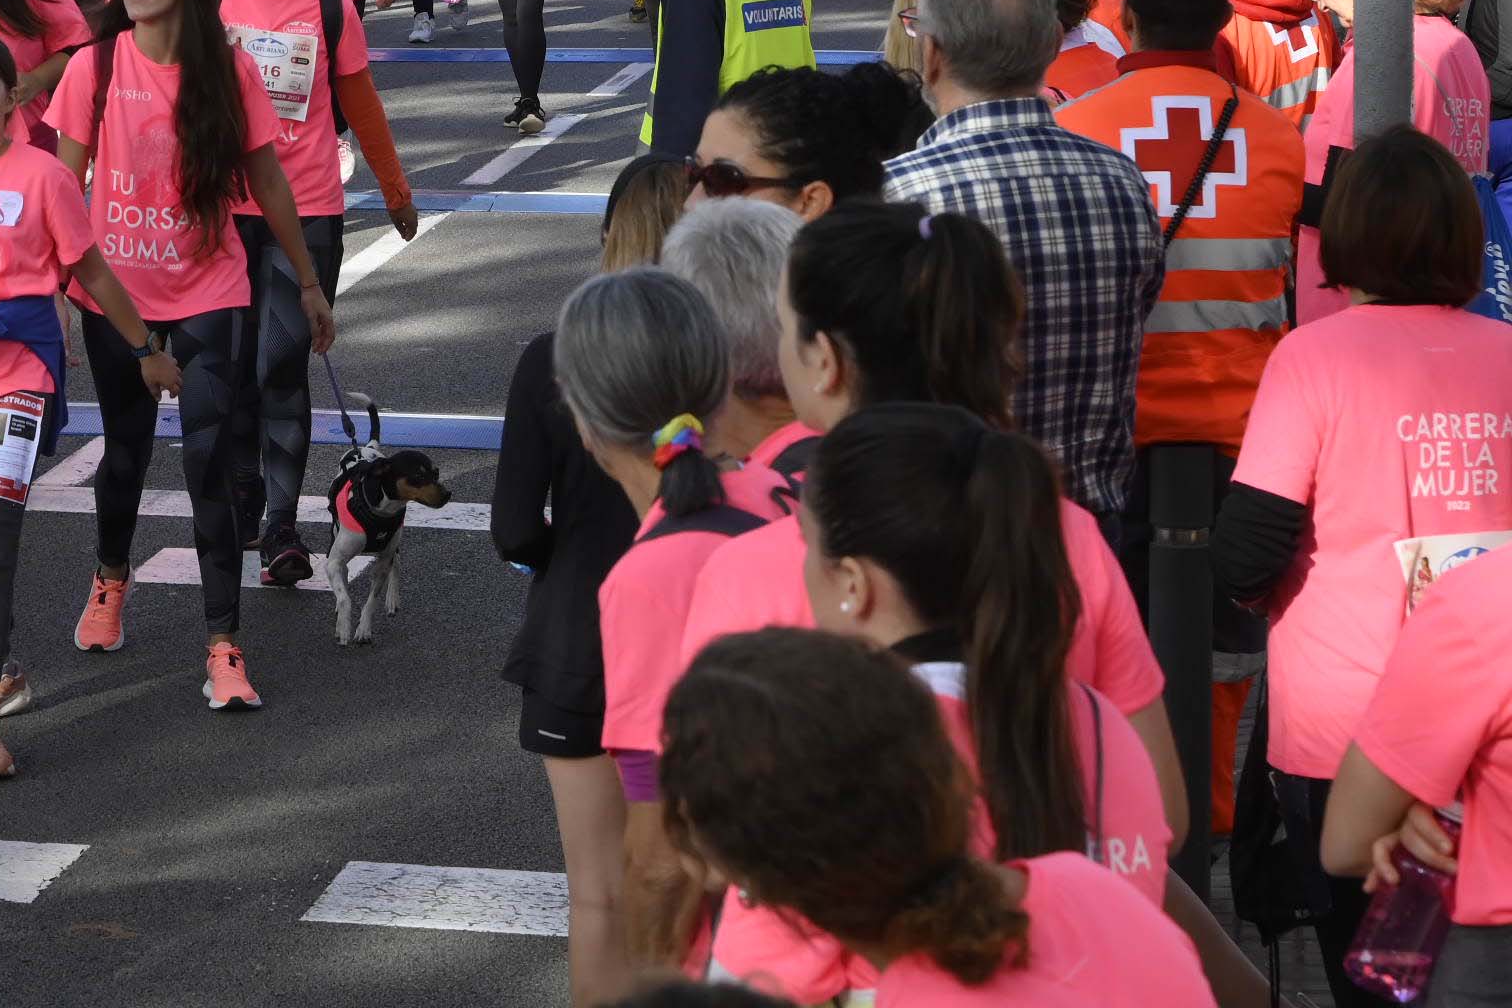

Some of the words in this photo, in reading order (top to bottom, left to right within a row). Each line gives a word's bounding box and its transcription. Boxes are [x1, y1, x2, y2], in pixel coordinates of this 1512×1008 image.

[744, 5, 804, 25] VOLUNTARIS
[260, 64, 281, 78] 16
[110, 169, 135, 196] TU
[107, 201, 201, 231] DORSA
[104, 234, 180, 262] SUMA
[1419, 442, 1451, 469] DE
[1462, 442, 1495, 468] LA
[1411, 469, 1498, 497] MUJER
